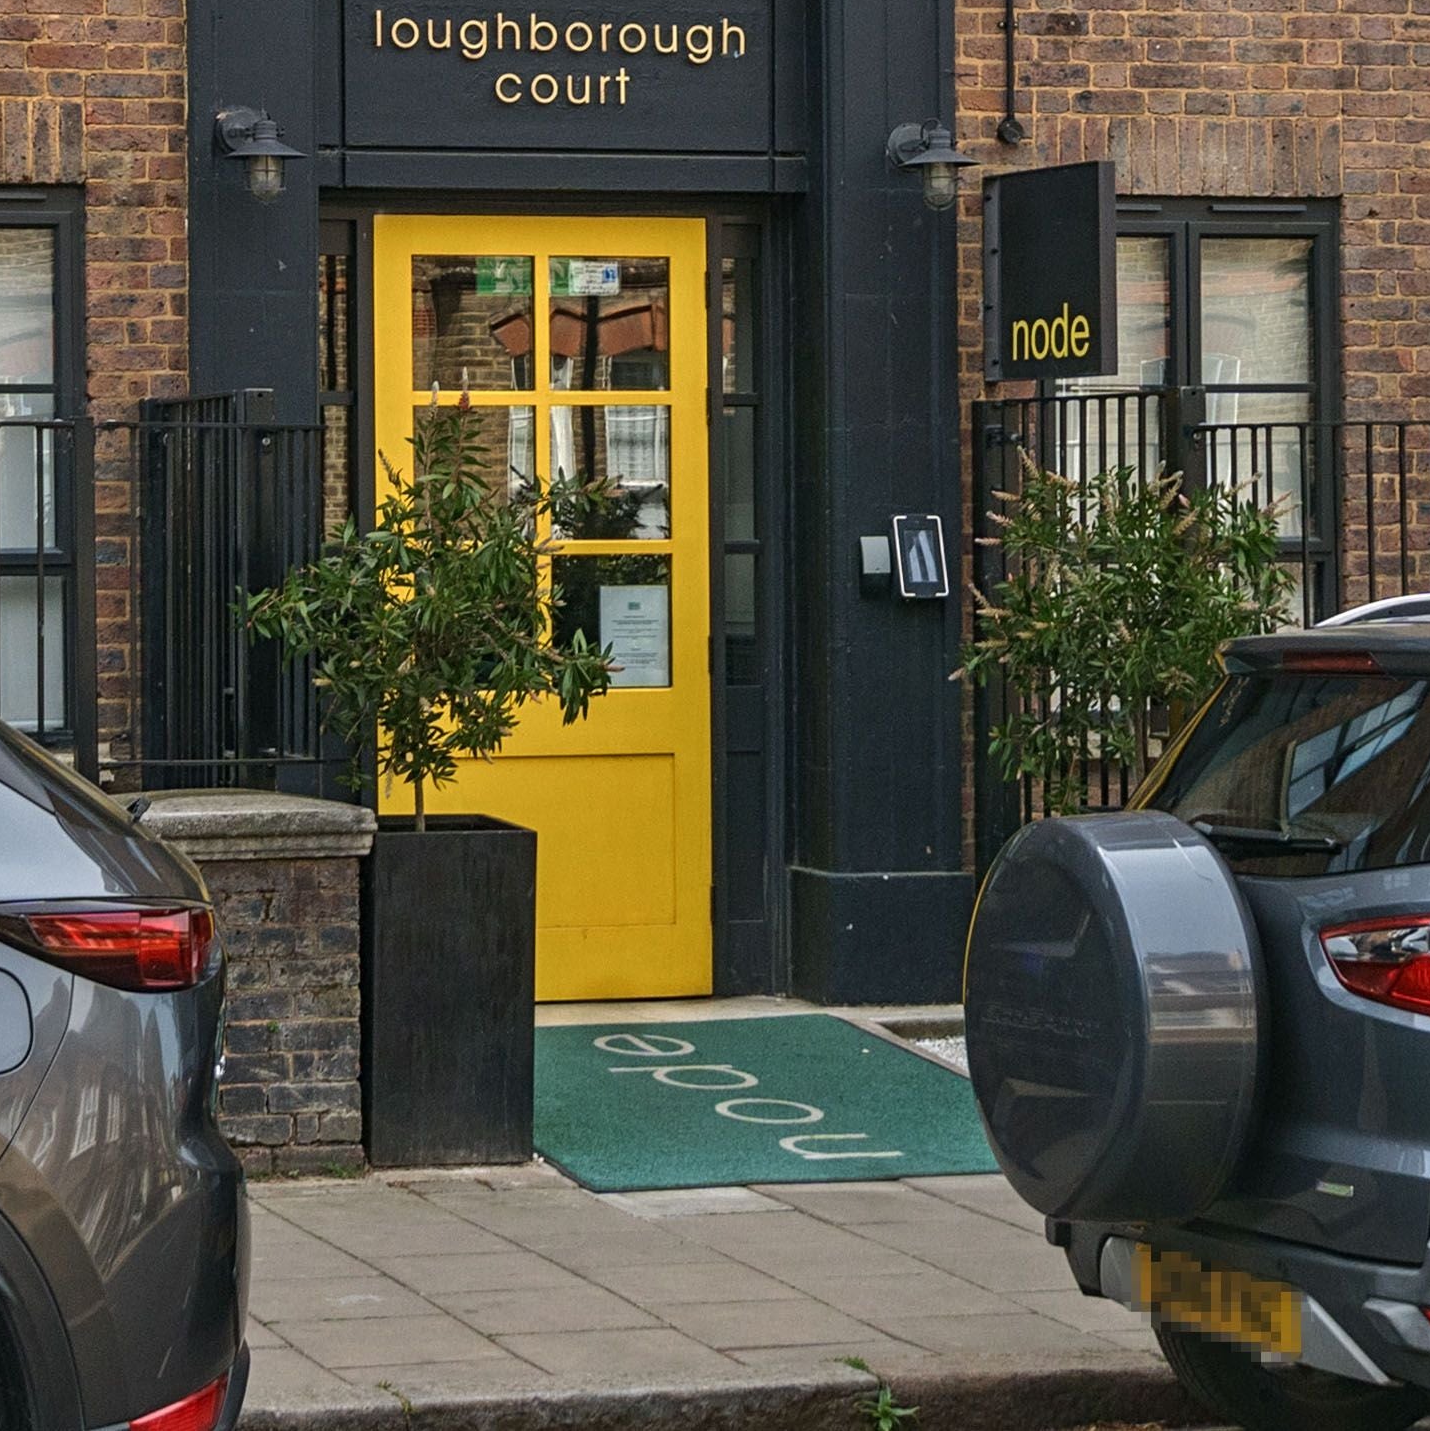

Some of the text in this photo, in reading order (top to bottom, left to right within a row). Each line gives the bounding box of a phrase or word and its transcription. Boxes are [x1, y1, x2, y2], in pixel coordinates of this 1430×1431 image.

[374, 9, 747, 64] loughborough
[494, 67, 631, 106] court
[1011, 301, 1091, 362] node
[592, 1032, 905, 1161] node
